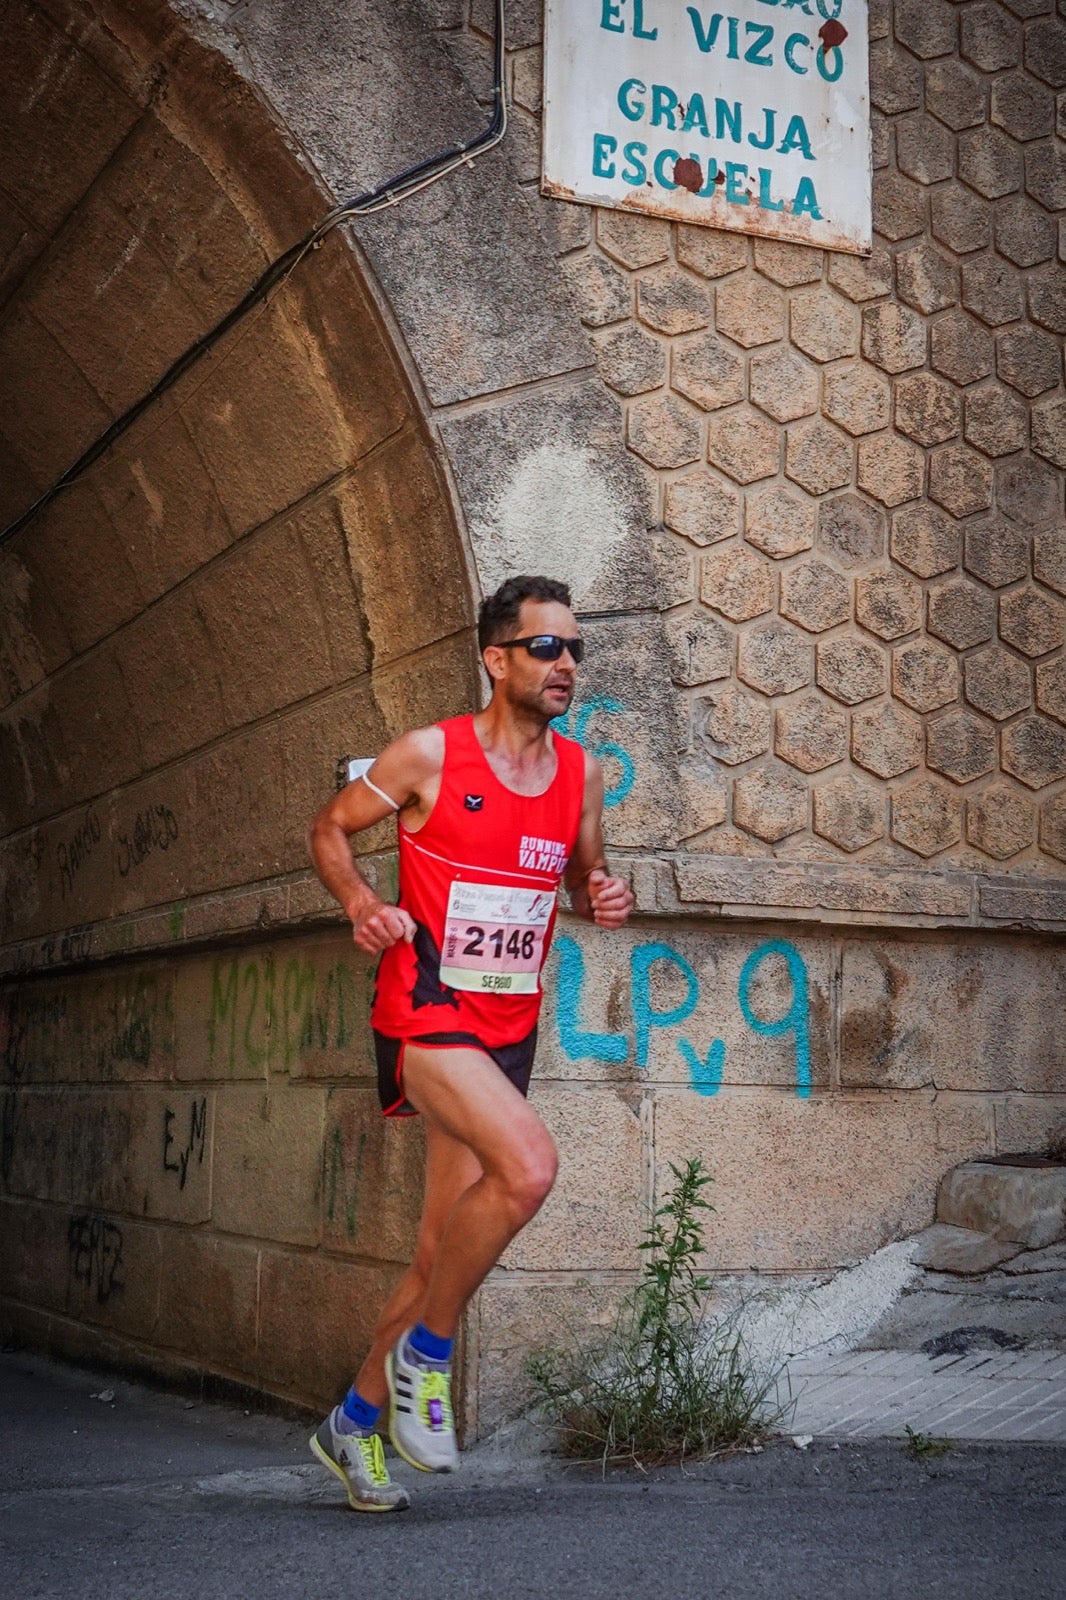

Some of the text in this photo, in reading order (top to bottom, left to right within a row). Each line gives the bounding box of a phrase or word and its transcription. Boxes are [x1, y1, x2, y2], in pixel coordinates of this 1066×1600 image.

[600, 0, 844, 83] EL VIZCO
[617, 78, 817, 161] GRANJA
[462, 925, 535, 960] 2148
[481, 974, 513, 989] SERGIO
